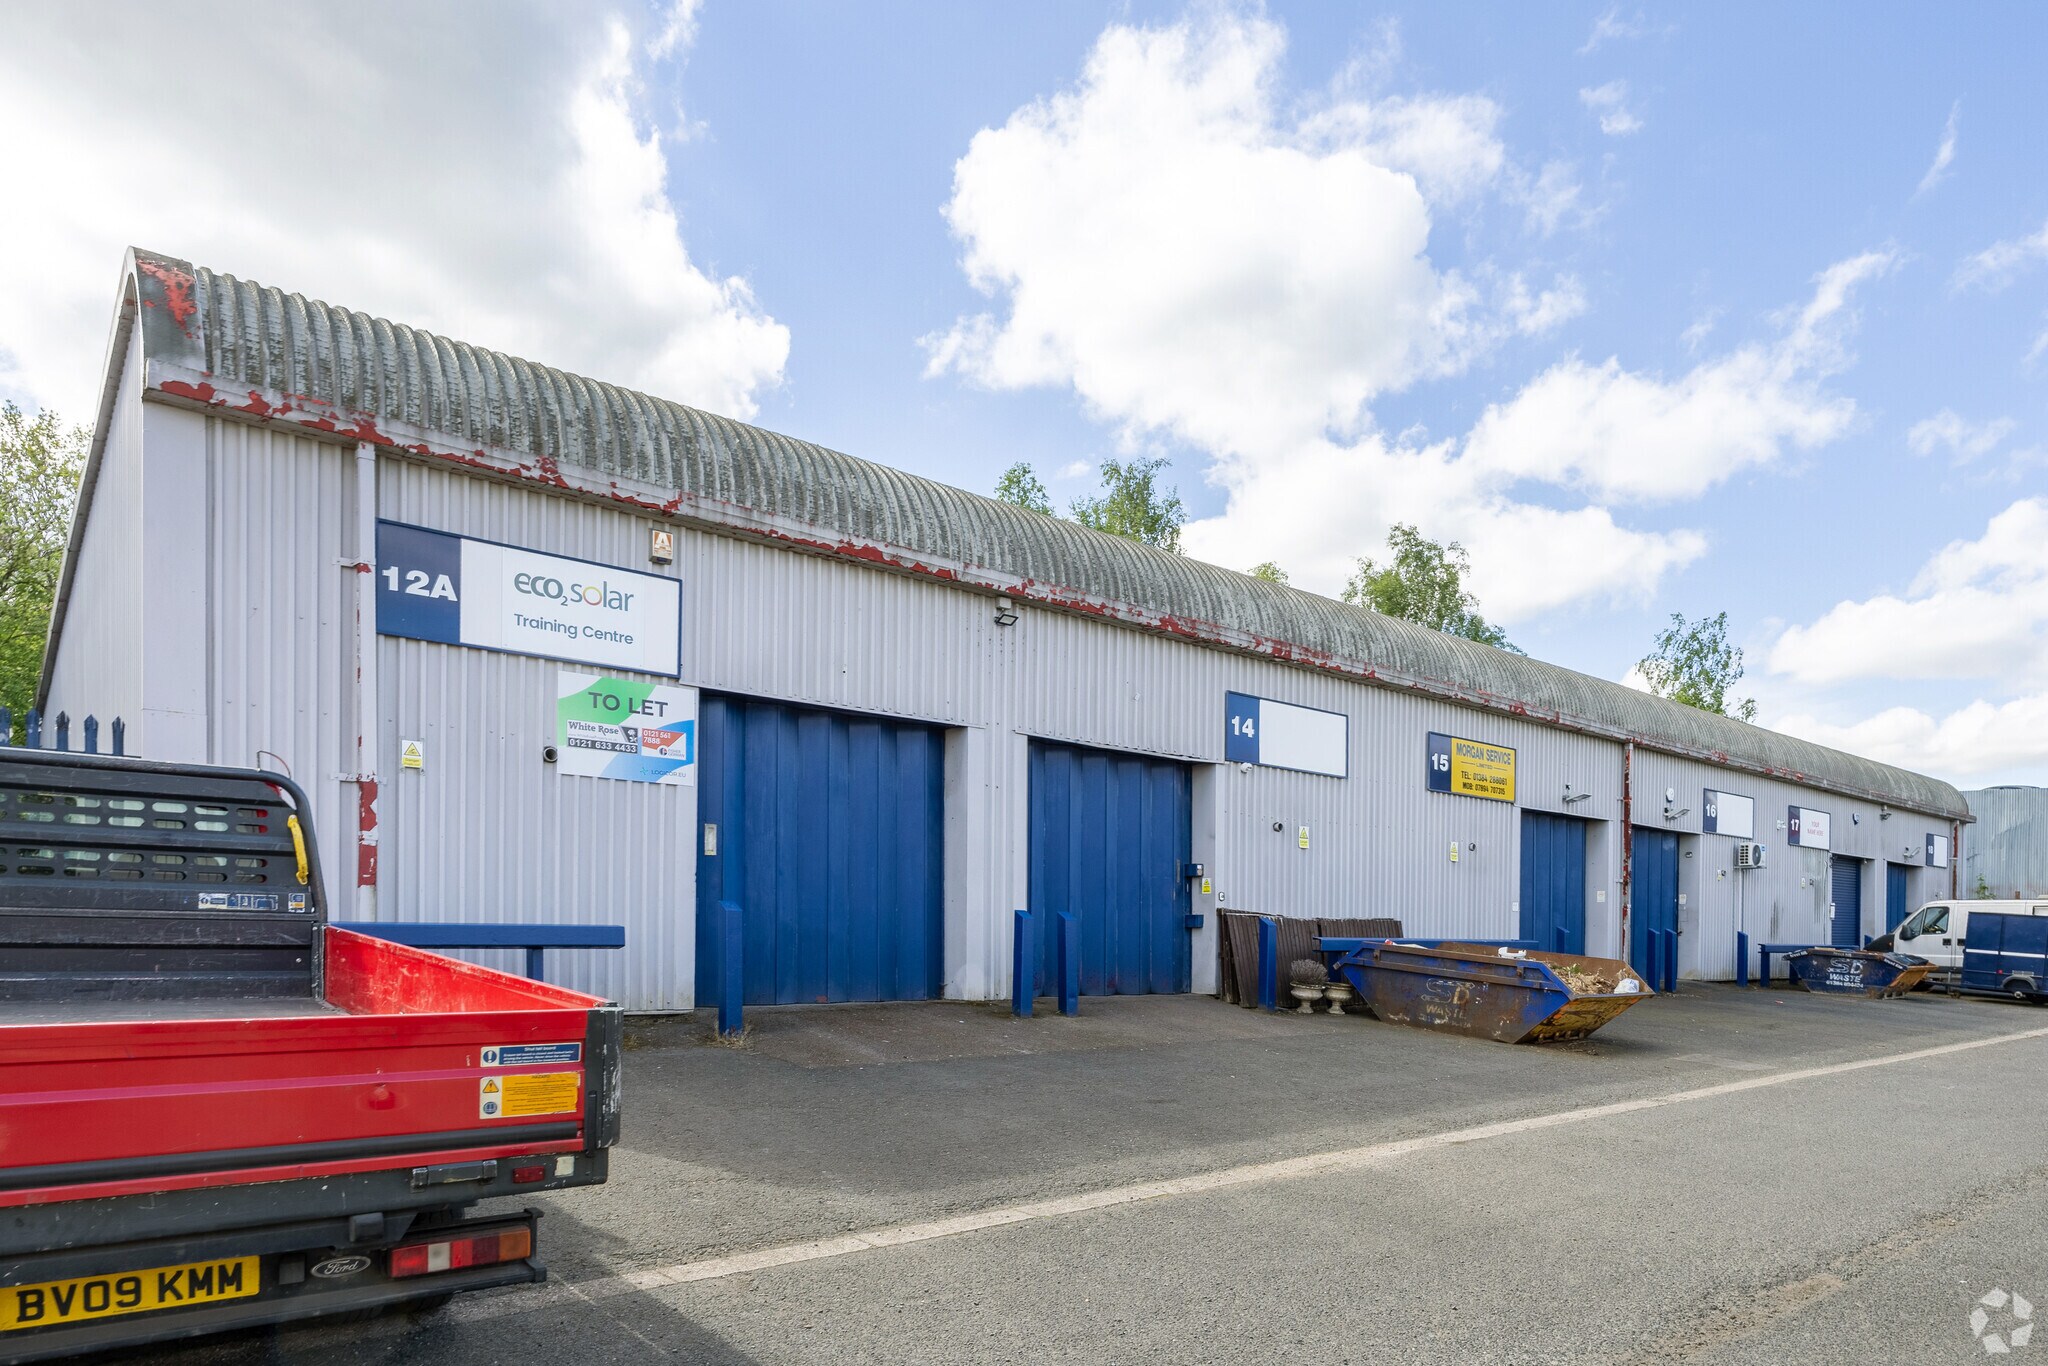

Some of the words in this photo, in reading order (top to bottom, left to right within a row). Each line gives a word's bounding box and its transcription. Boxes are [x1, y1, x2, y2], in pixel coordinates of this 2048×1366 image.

[382, 566, 458, 602] 12A
[513, 613, 578, 639] Training
[582, 625, 634, 645] Centre
[588, 691, 620, 711] TO
[628, 697, 668, 717] LET
[568, 721, 596, 732] White
[598, 725, 619, 736] Rose
[643, 730, 659, 738] 0121
[1231, 715, 1255, 738] 14
[569, 739, 592, 748] 0121
[595, 741, 612, 750] 633
[614, 744, 637, 753] 4433
[1456, 742, 1485, 760] MORGAN
[1485, 748, 1511, 765] SERVICE
[1431, 753, 1449, 772] 15
[1705, 803, 1717, 818] 16
[1790, 819, 1800, 832] 17
[1830, 973, 1863, 983] WASTE
[323, 1259, 359, 1275] Ford
[16, 1276, 142, 1323] BV09
[157, 1261, 244, 1303] KMM
